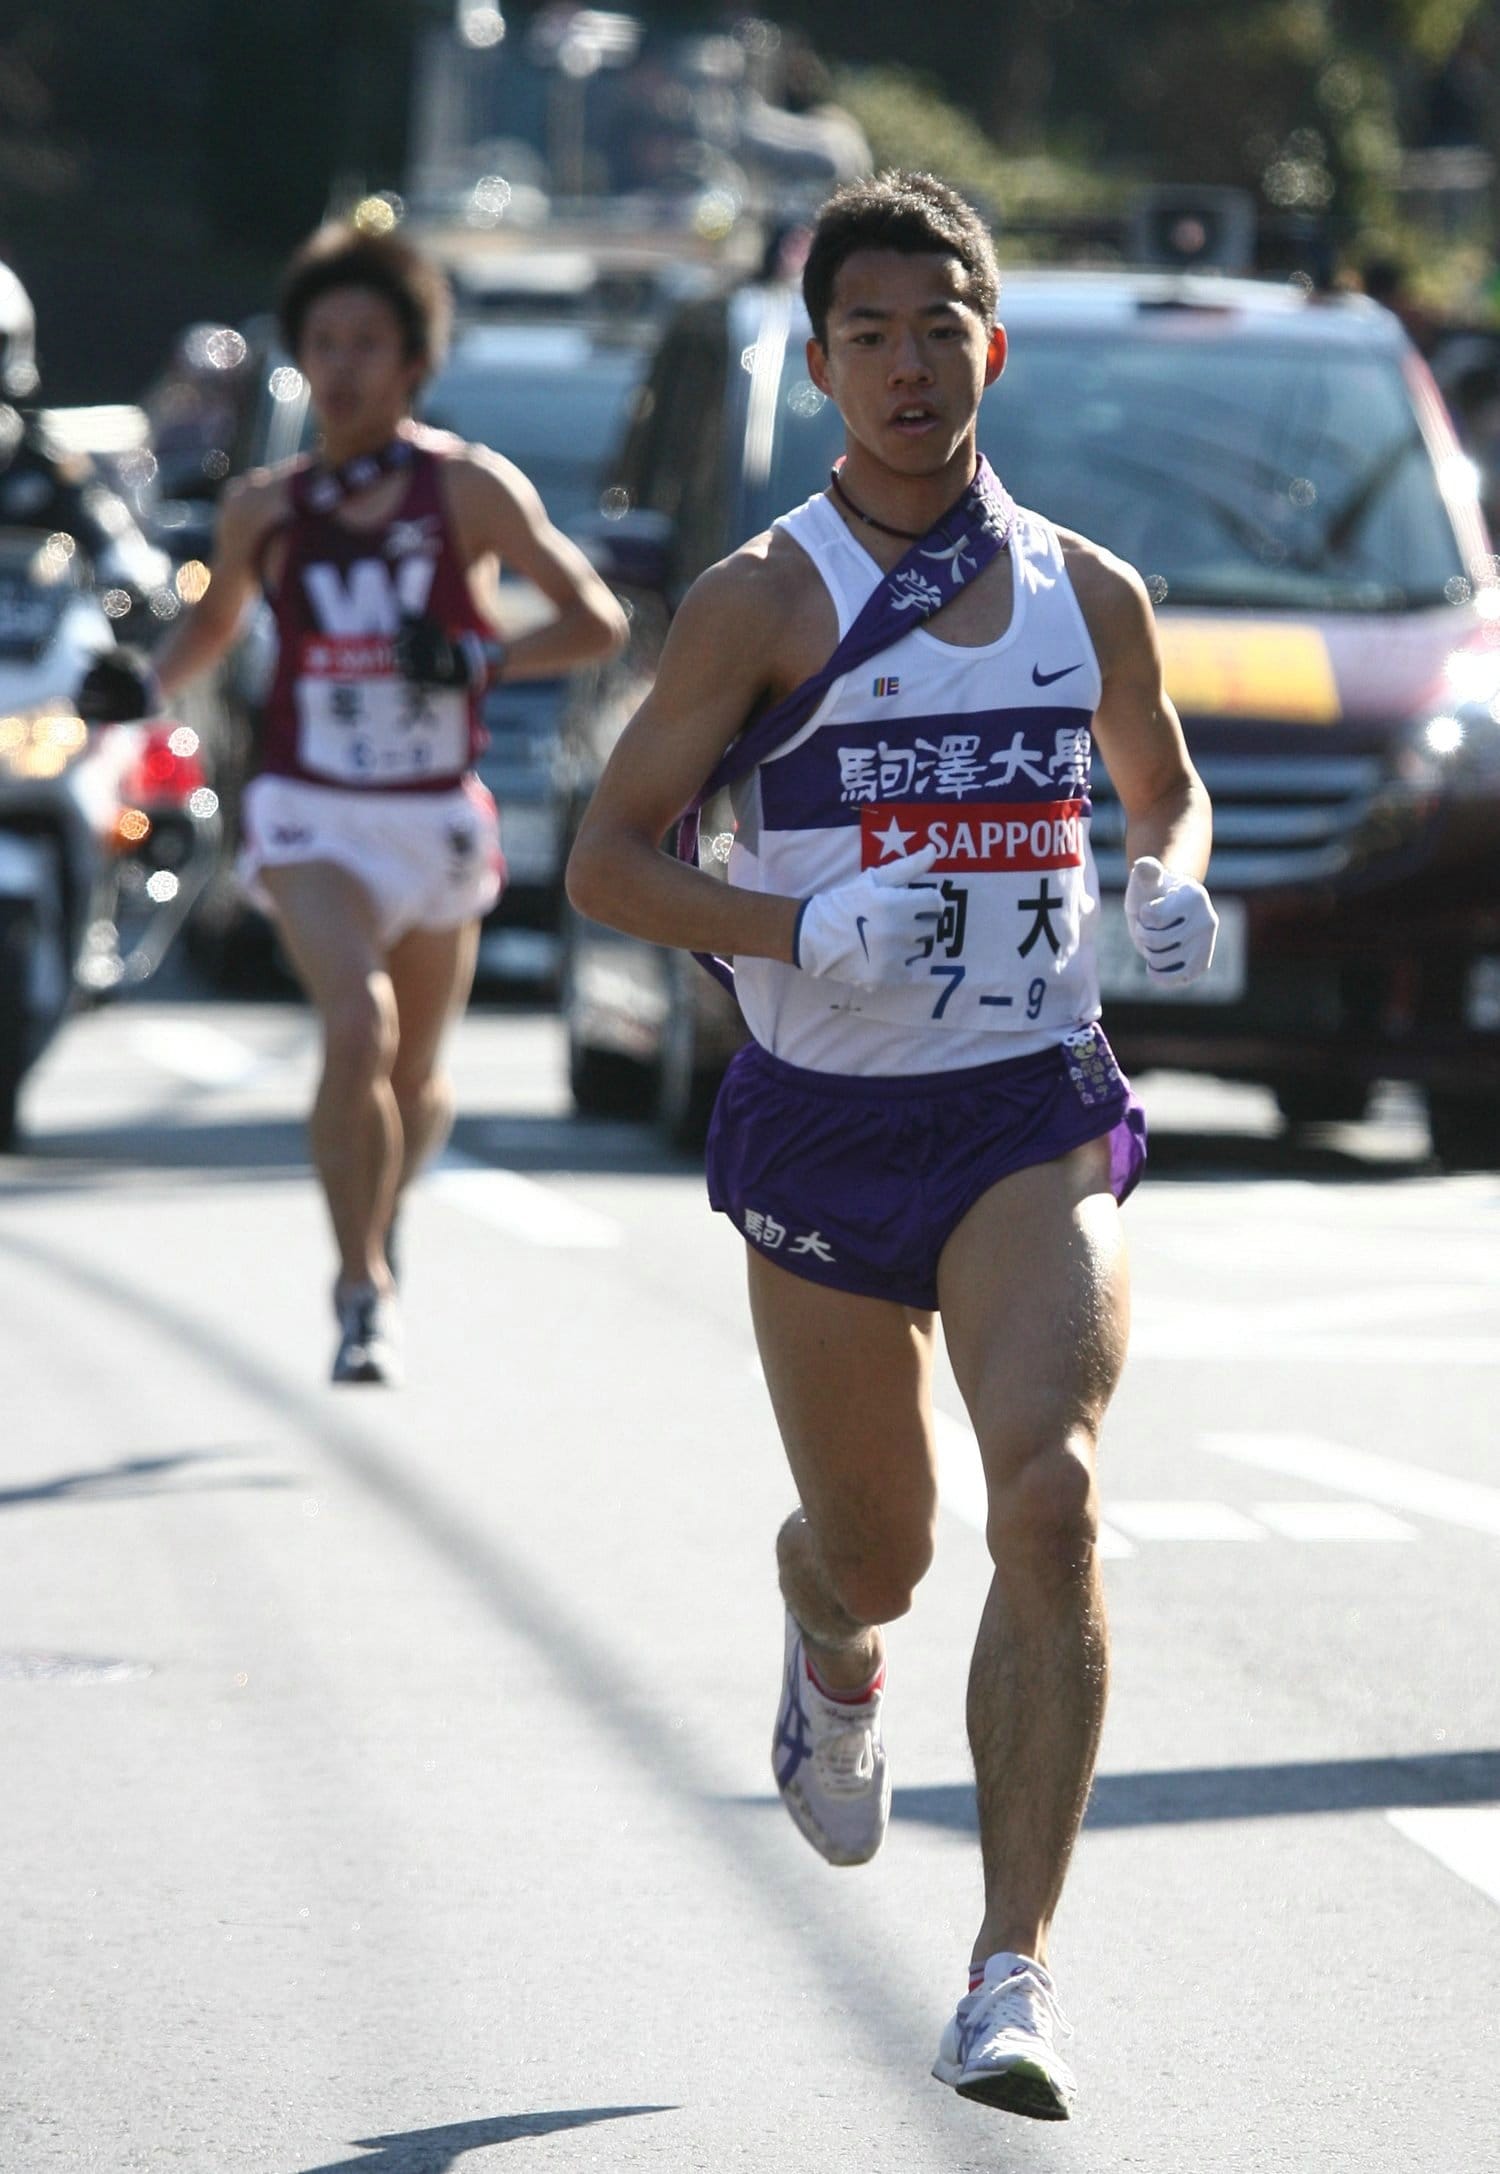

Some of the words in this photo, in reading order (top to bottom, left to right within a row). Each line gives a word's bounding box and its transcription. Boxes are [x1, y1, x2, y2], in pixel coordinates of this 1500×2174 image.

[302, 557, 436, 633] W
[930, 965, 1047, 1020] 7-9
[744, 1208, 837, 1263] 駒大
